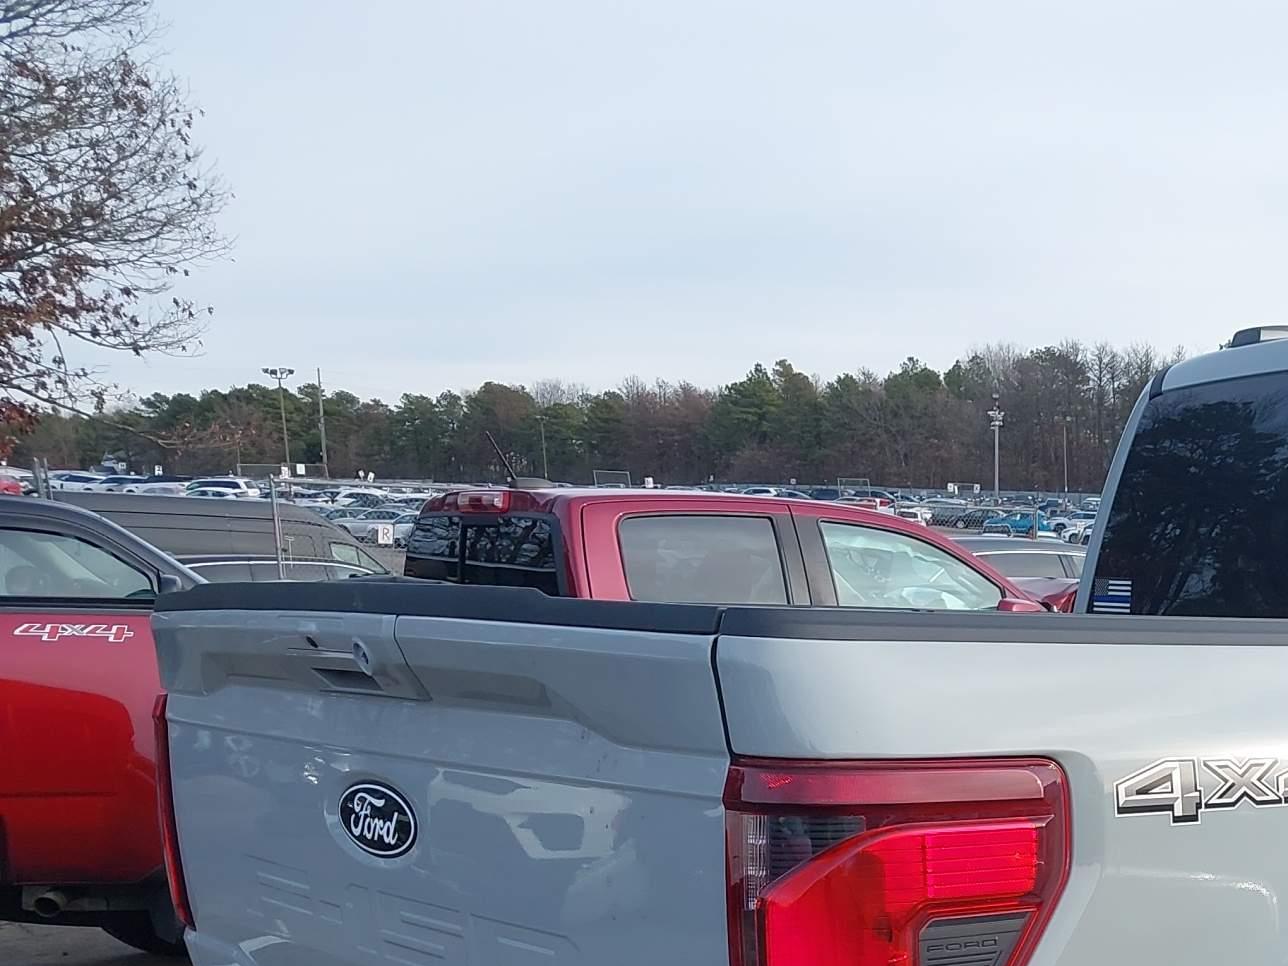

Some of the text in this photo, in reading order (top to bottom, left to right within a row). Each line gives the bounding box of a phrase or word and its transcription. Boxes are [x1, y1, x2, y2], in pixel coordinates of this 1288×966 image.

[382, 527, 391, 541] R
[350, 792, 399, 846] Ford
[926, 938, 998, 953] FORD
